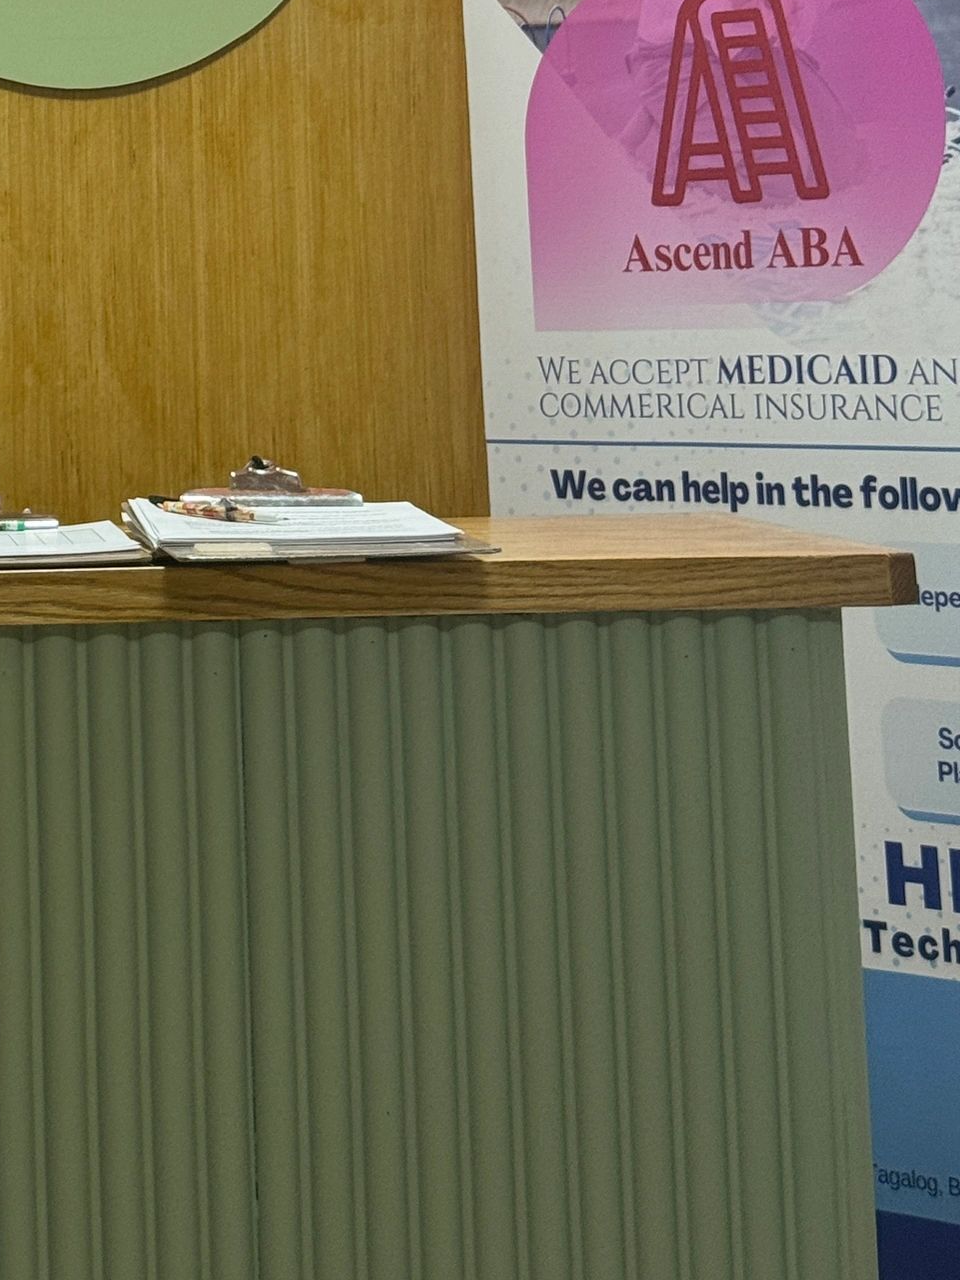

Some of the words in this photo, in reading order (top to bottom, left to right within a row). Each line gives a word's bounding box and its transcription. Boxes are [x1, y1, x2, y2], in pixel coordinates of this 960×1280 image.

[622, 229, 755, 272] Ascend
[766, 226, 864, 268] ABA
[537, 356, 582, 385] WE
[589, 358, 708, 385] ACCEPT
[716, 354, 898, 385] MEDICAID
[540, 392, 746, 419] COMMERICAL
[754, 393, 944, 422] INSURANCE
[550, 469, 607, 501] We
[612, 478, 676, 502] can
[681, 470, 750, 512] help
[755, 471, 786, 506] in
[792, 474, 854, 508] the
[873, 1163, 944, 1197] agalog,
